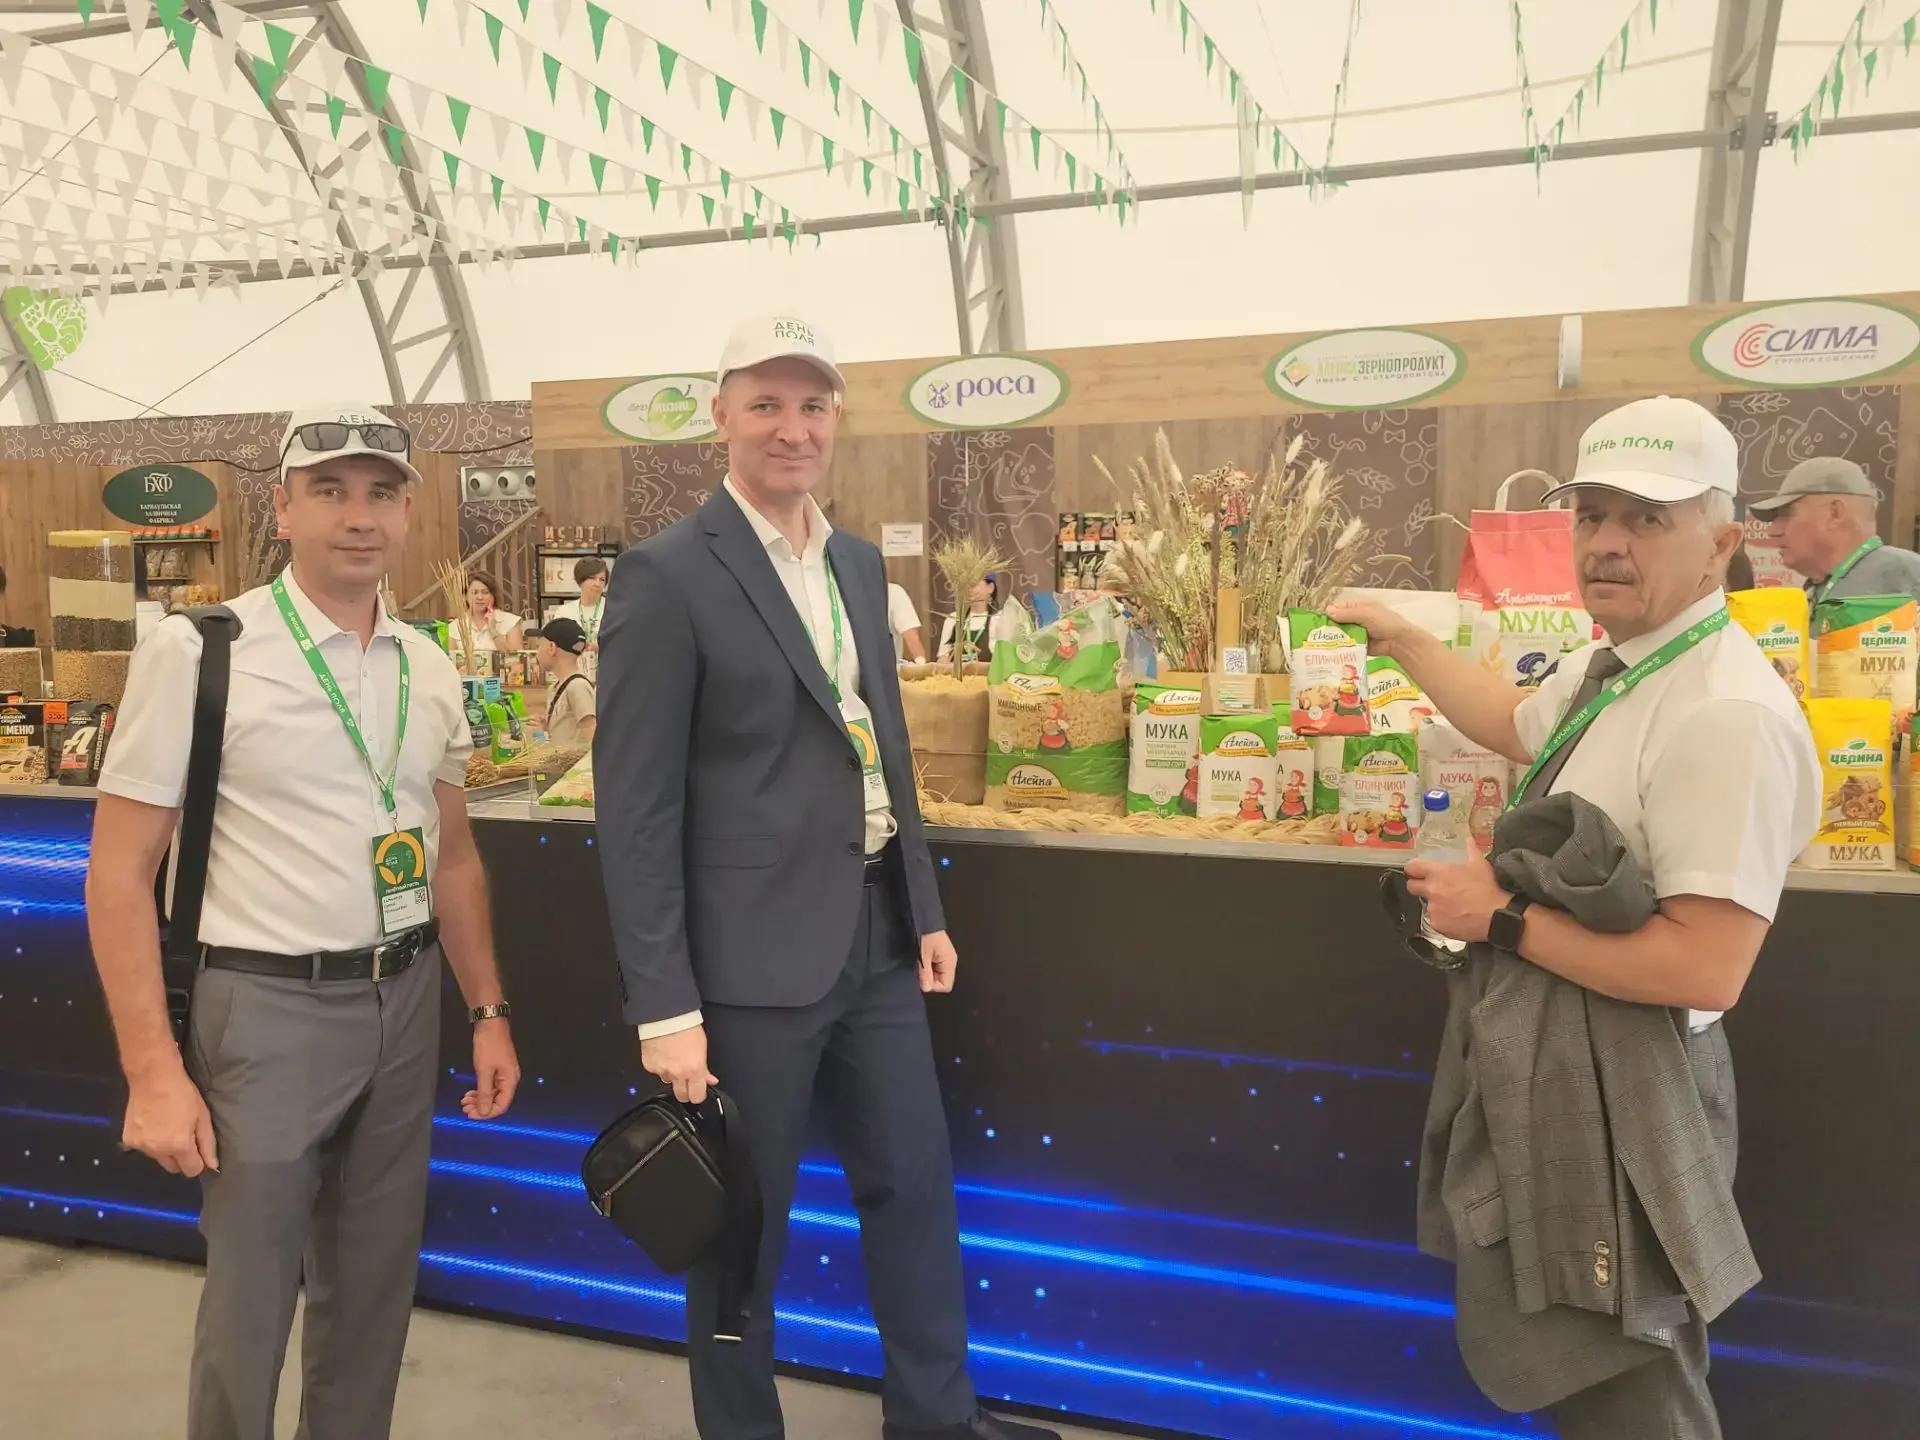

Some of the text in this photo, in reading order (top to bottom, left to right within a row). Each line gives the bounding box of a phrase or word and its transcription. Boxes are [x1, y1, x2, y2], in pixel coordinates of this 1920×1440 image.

[774, 320, 815, 338] ДЕНЬ
[775, 329, 816, 347] ПОЛЯ
[1765, 324, 1879, 353] СИГМА
[956, 374, 1036, 408] роса
[337, 414, 376, 425] ДЕН
[1622, 436, 1675, 452] ПОЛЯ
[143, 472, 174, 494] БХФ
[1499, 610, 1578, 634] МУКА
[1756, 636, 1800, 648] ЦЕЛИНА
[1861, 636, 1907, 647] ЦЕЛИНА
[1304, 652, 1358, 666] БЛИНЧИКИ
[1860, 656, 1905, 673] МУКА
[319, 673, 346, 714] ДЕНЬ ПОЛЯ
[1145, 723, 1189, 740] МУКА
[1830, 753, 1884, 765] ЦЕЛИНА
[1011, 770, 1054, 786] Алейка
[1211, 769, 1242, 782] МУКА
[1440, 773, 1474, 784] МУКА
[1355, 779, 1407, 791] БЛИНЧИКИ
[1847, 835, 1868, 843] 2 кг
[1829, 845, 1884, 861] МУКА
